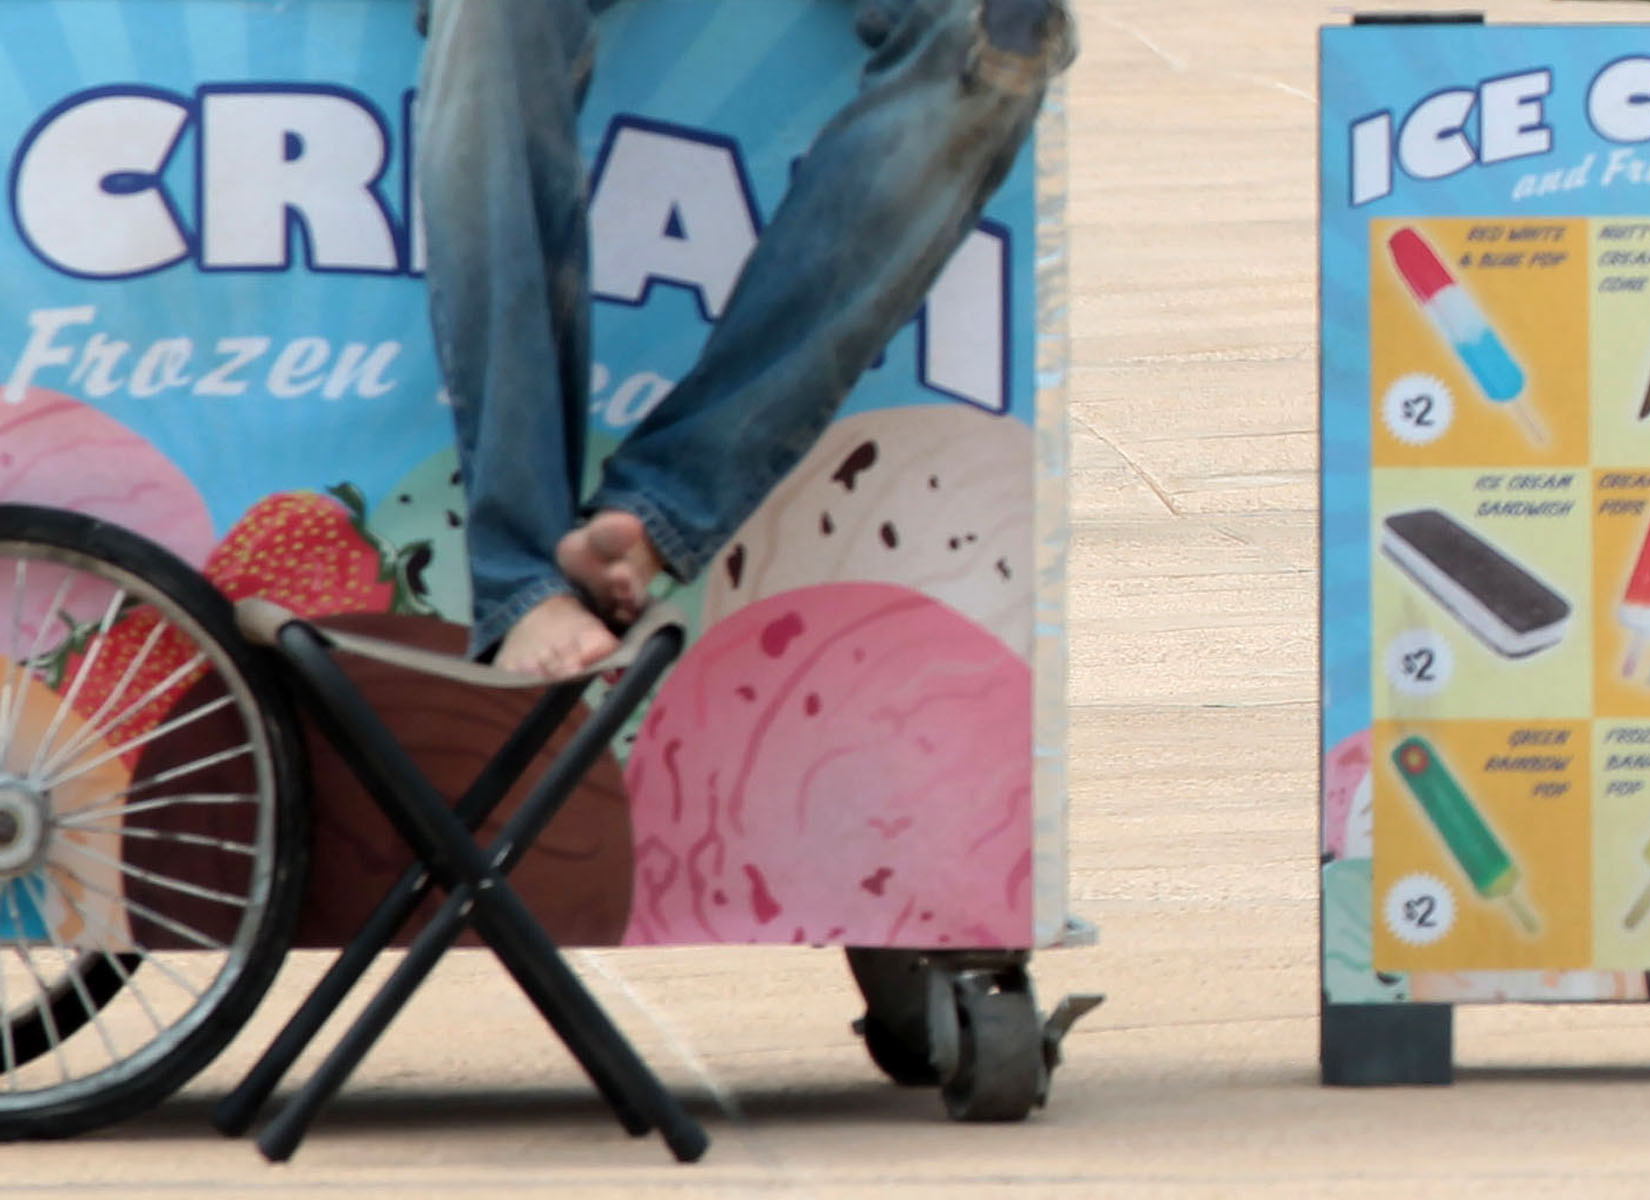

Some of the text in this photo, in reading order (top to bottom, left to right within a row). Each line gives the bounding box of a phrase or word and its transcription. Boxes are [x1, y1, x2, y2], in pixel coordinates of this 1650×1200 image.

[1347, 65, 1554, 208] ICE
[1511, 153, 1597, 201] and
[1467, 225, 1567, 242] RED WHITE
[12, 83, 1012, 415] CRA
[1458, 252, 1569, 269] & BLUE POP
[1599, 275, 1649, 292] CONE
[4, 305, 403, 403] Frozen
[1402, 393, 1435, 426] $2
[1474, 474, 1575, 491] ICE CREAM
[1476, 500, 1575, 518] SANDWICH
[1402, 647, 1435, 681] $2
[1509, 729, 1572, 746] GREEN
[1484, 755, 1573, 772] RAINBOW
[1532, 781, 1571, 798] POP
[1603, 780, 1645, 797] POP
[1403, 895, 1437, 928] $2
